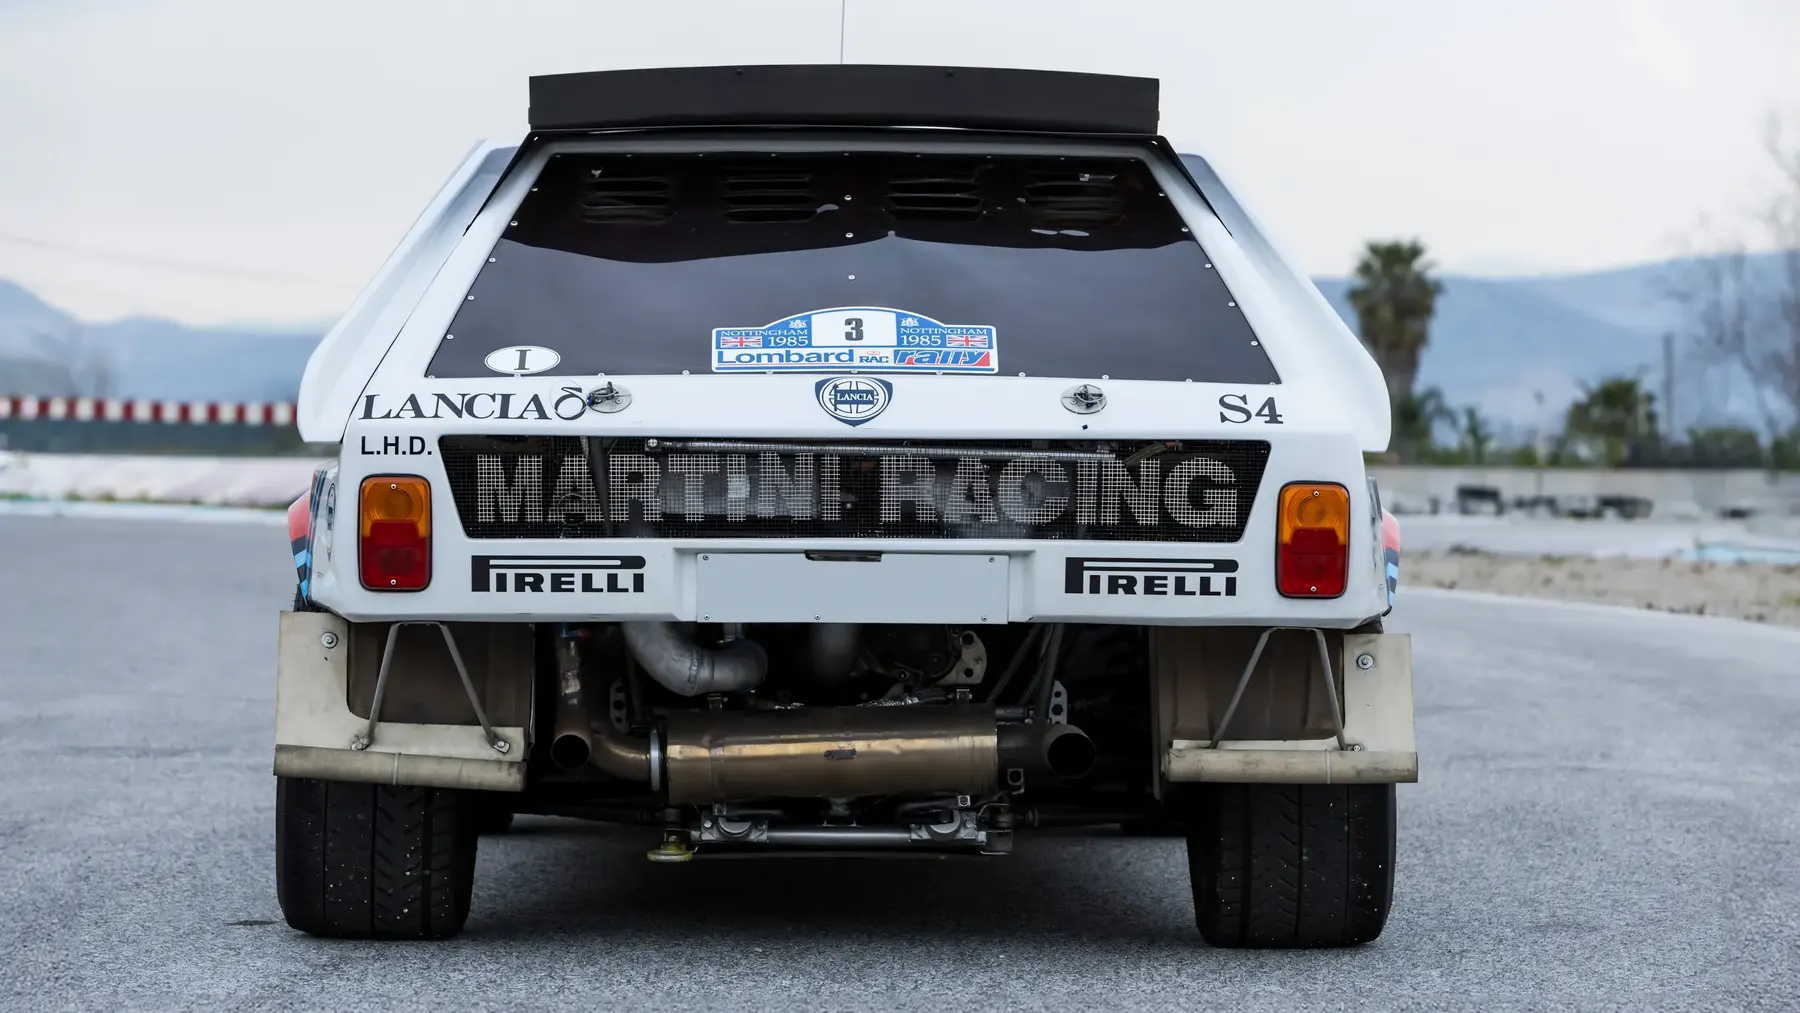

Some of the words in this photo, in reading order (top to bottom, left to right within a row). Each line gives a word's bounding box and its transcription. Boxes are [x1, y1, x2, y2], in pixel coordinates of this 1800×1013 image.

[721, 329, 808, 337] NOTTINGHAM
[844, 318, 864, 341] 3
[900, 327, 987, 335] NOTTINGHAM
[900, 334, 942, 346] 1985
[768, 335, 809, 347] 1985
[513, 349, 532, 371] I
[717, 349, 855, 364] Lombard
[859, 355, 889, 364] RAC
[896, 350, 985, 366] rally
[358, 393, 552, 420] LANCIA
[837, 393, 874, 401] LANCIA
[1218, 394, 1284, 425] S4
[360, 435, 433, 456] L.H.D.
[476, 452, 841, 523] MARTINI
[879, 454, 1238, 528] RACING
[471, 555, 647, 593] PIRELLI
[1064, 557, 1239, 597] PIRELLI
